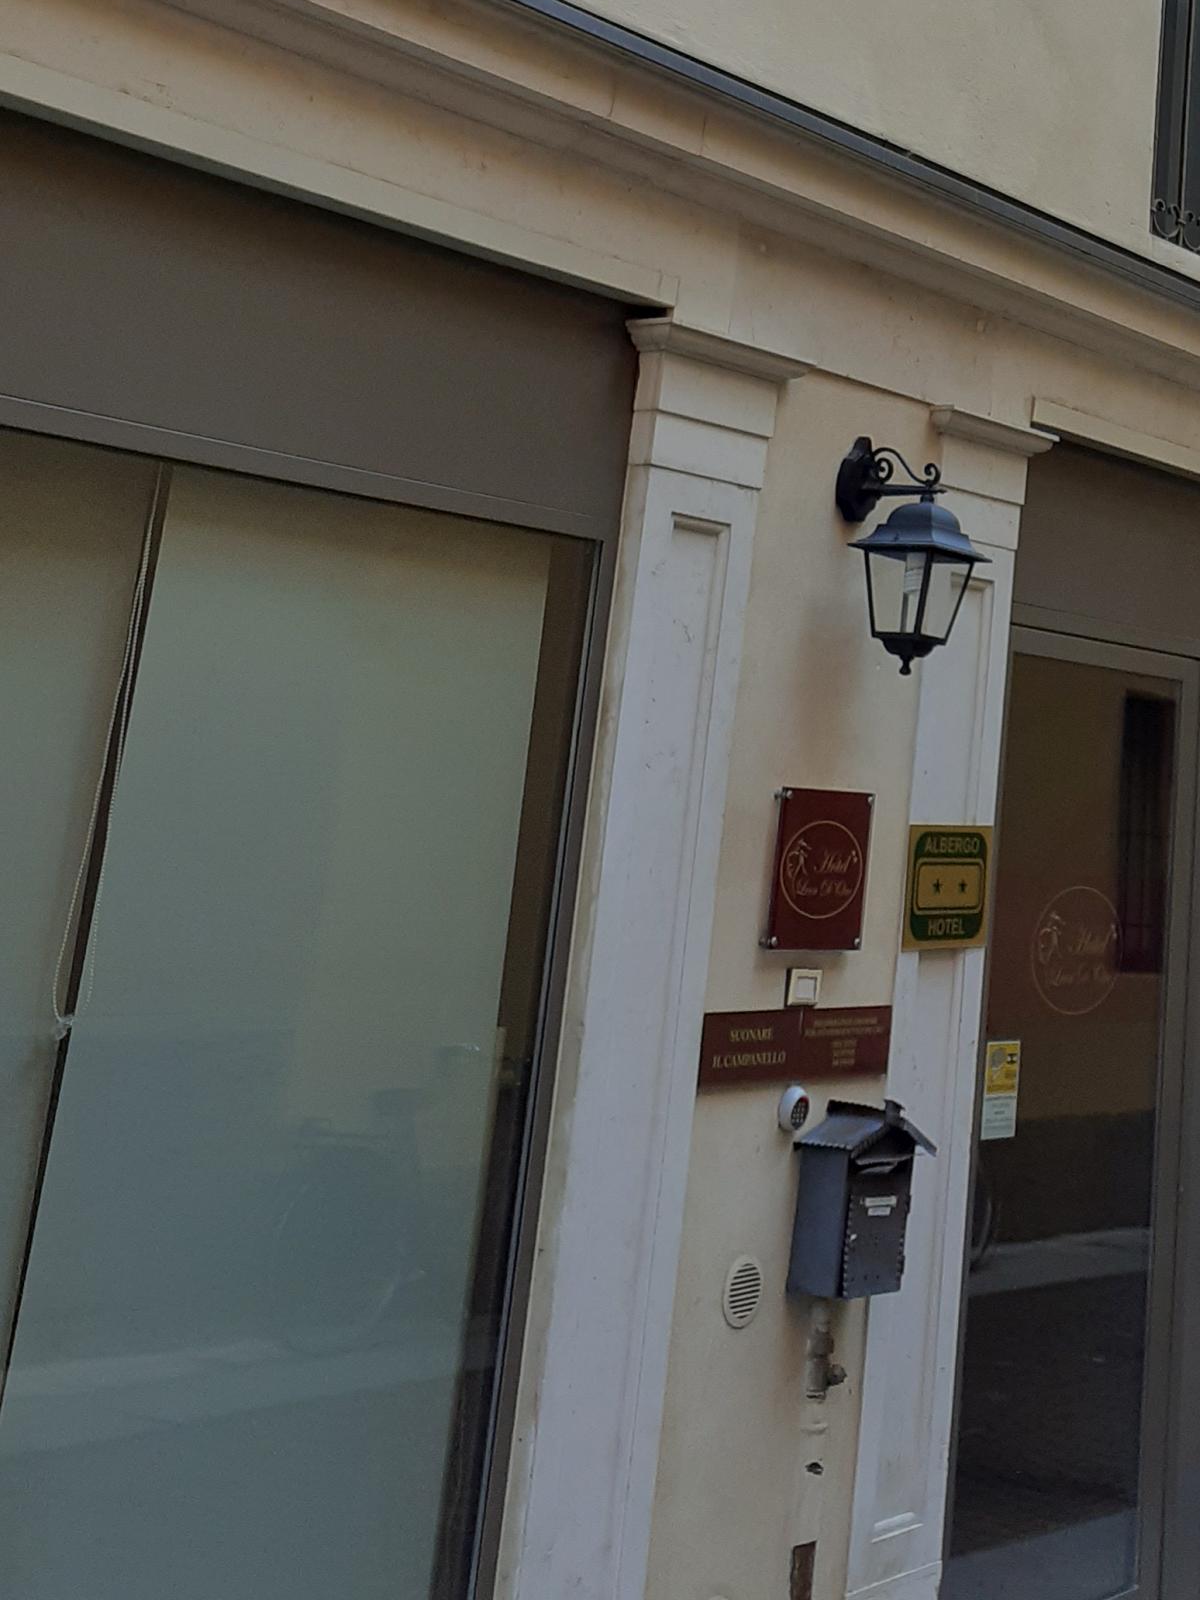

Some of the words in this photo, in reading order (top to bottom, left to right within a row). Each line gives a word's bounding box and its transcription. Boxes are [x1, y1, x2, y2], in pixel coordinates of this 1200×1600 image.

[924, 836, 980, 854] ALBERGO
[927, 918, 966, 936] HOTEL
[729, 1026, 774, 1043] SUONARE
